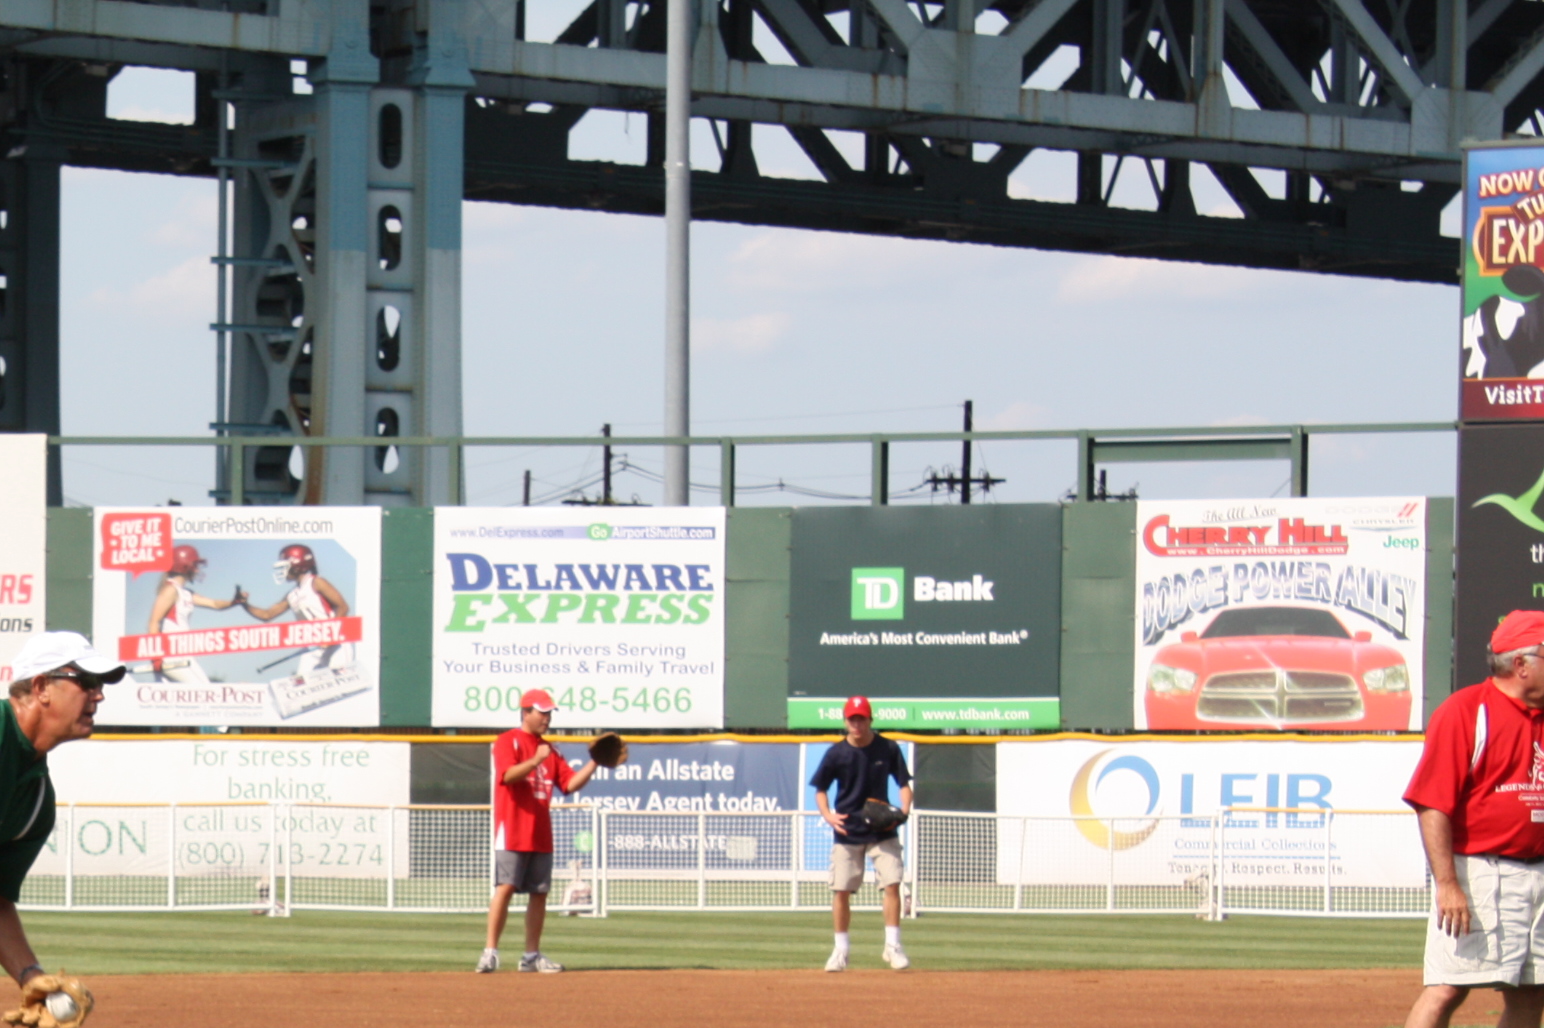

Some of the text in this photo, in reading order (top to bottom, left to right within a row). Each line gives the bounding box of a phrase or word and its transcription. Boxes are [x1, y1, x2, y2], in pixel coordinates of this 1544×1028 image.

[1479, 169, 1534, 197] NOW
[1203, 509, 1224, 522] The
[1249, 504, 1277, 519] New
[110, 517, 162, 536] GIVE IT
[174, 517, 333, 534] CourierPostOnline.com
[450, 527, 564, 540] www.DelExpress.com
[1143, 514, 1348, 556] CHERRY HILL
[121, 532, 162, 549] TO ME
[1383, 535, 1419, 549] Jeep
[112, 547, 156, 565] LOCAL
[445, 553, 714, 591] DELAWARE
[856, 574, 995, 609] TD Bank
[444, 593, 714, 632] EXPRESS
[1143, 561, 1416, 646] DODGE POWER ALLEY
[137, 620, 346, 658] ALL THINGS SOUTH JERSEY.
[820, 631, 879, 645] America's
[881, 631, 913, 645] Most
[915, 631, 986, 645] Convenient
[472, 642, 686, 659] Trusted Drivers Serving
[444, 660, 715, 677] Your Business & Family Travel
[464, 686, 692, 713] 80048-5466
[922, 708, 1029, 722] www.tdbank.com
[193, 744, 369, 767] For stress free
[614, 763, 641, 780] an
[647, 759, 735, 781] Allstate
[646, 791, 713, 813] Agent
[717, 791, 782, 813] today.
[1179, 773, 1335, 828] LEIB
[183, 808, 376, 839] call us today at
[608, 835, 727, 850] -888-ALLSTTE
[1174, 838, 1256, 851] Commrcial
[178, 842, 383, 870] (800) 713-2274
[1294, 862, 1347, 876] Resuts.
